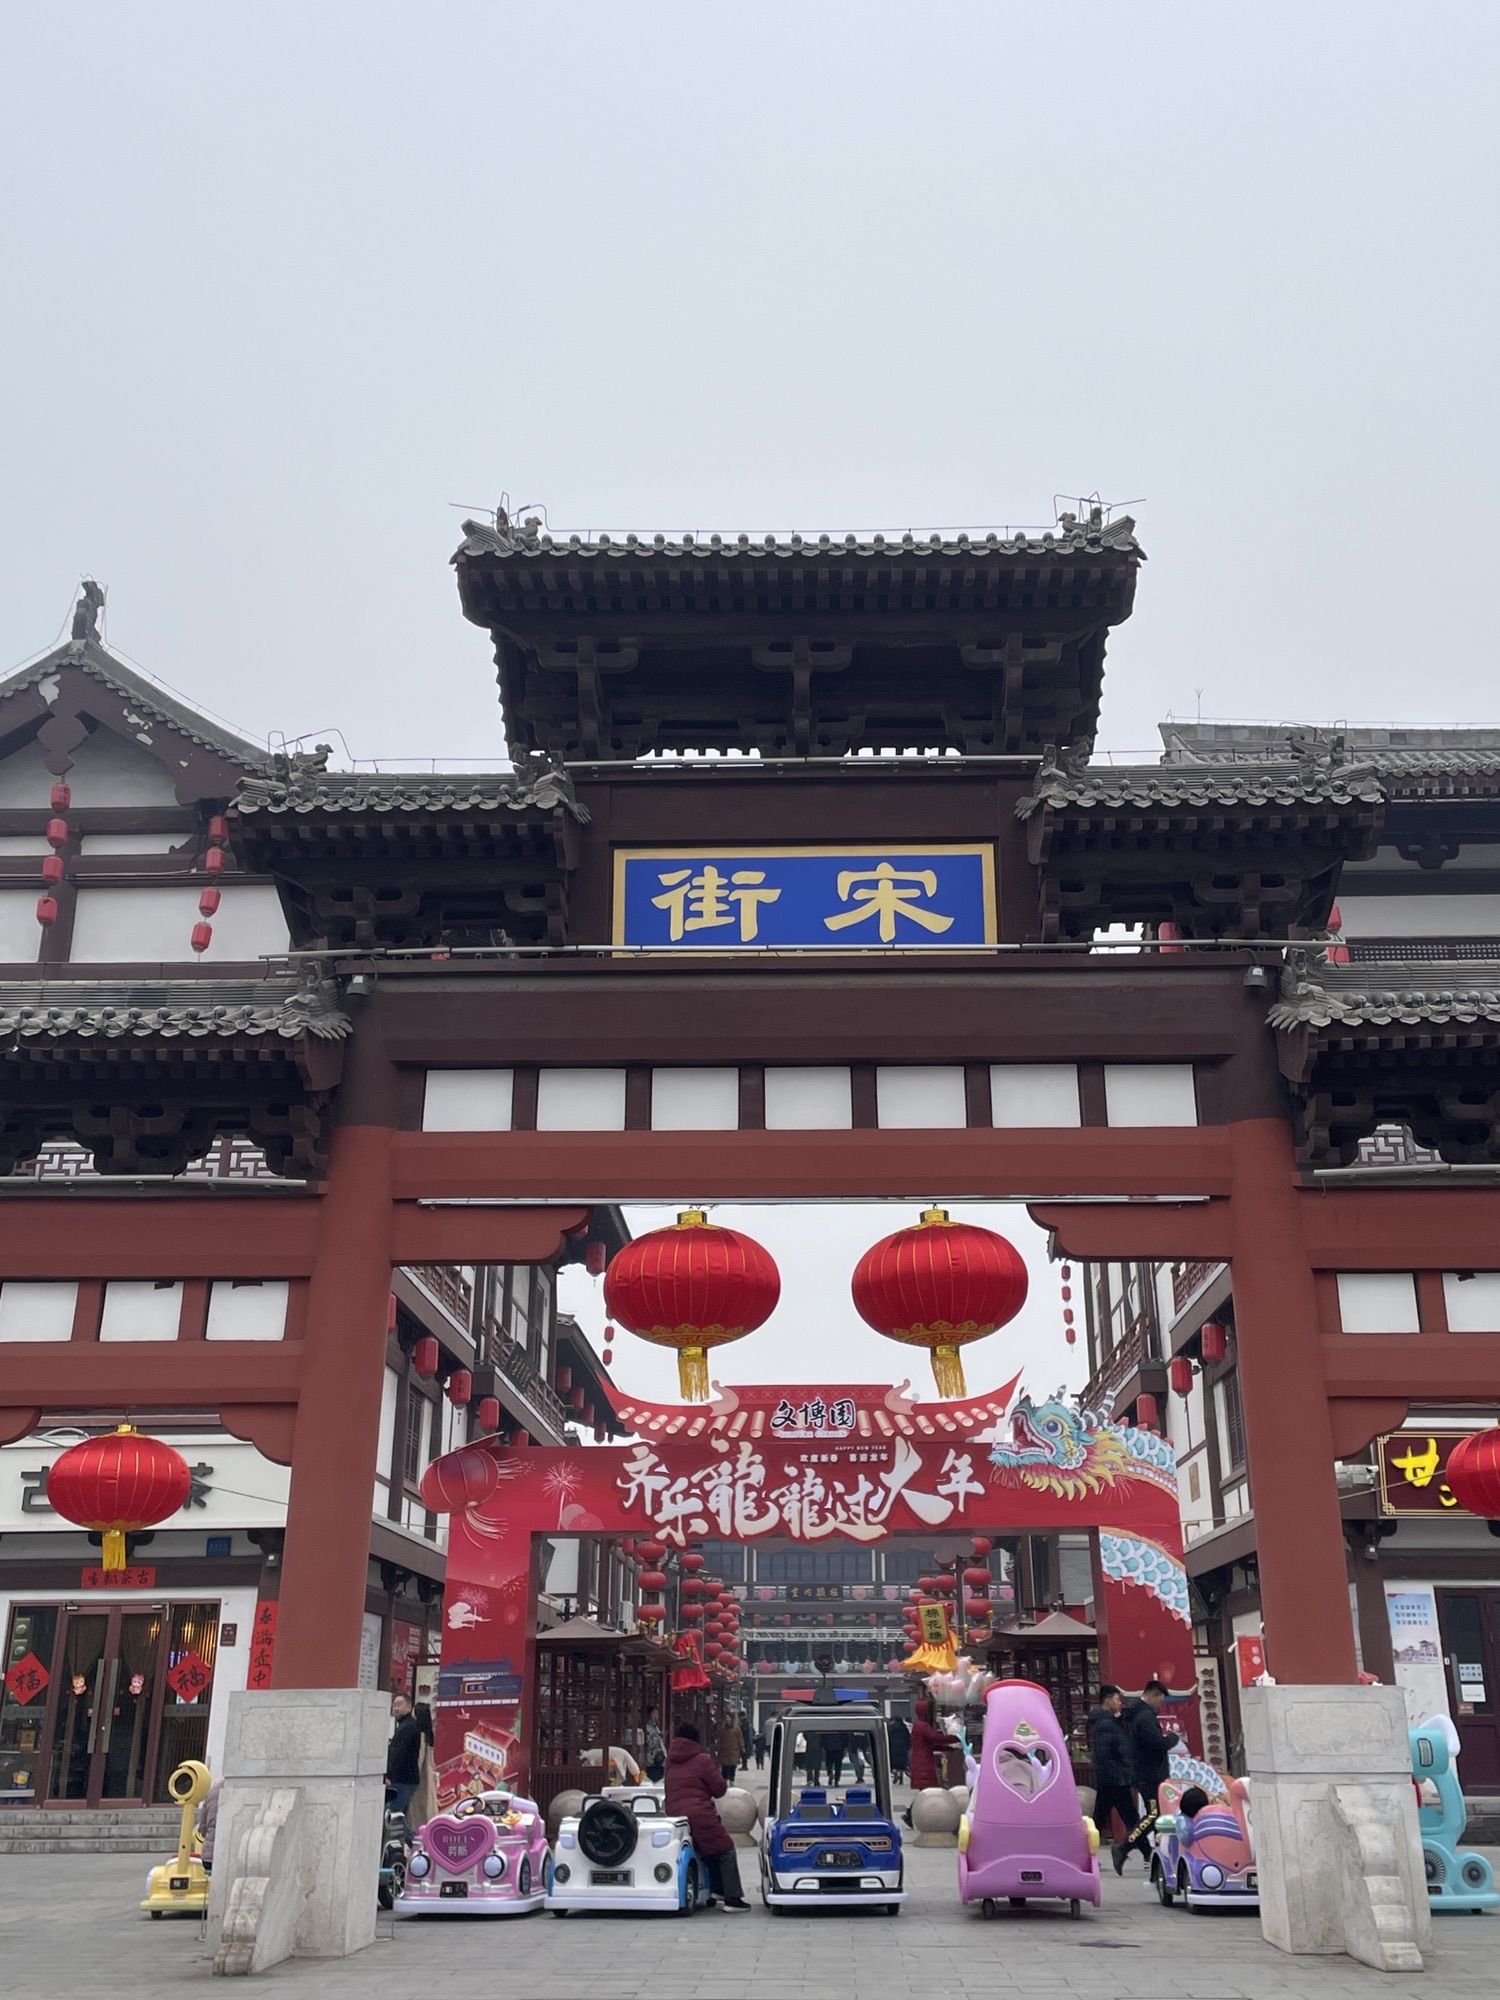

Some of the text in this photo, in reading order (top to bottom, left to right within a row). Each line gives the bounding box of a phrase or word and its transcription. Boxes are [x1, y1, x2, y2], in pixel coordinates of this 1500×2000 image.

[15, 1668, 41, 1693] 福
[177, 1664, 206, 1693] 福
[448, 1845, 468, 1857] 劳斯
